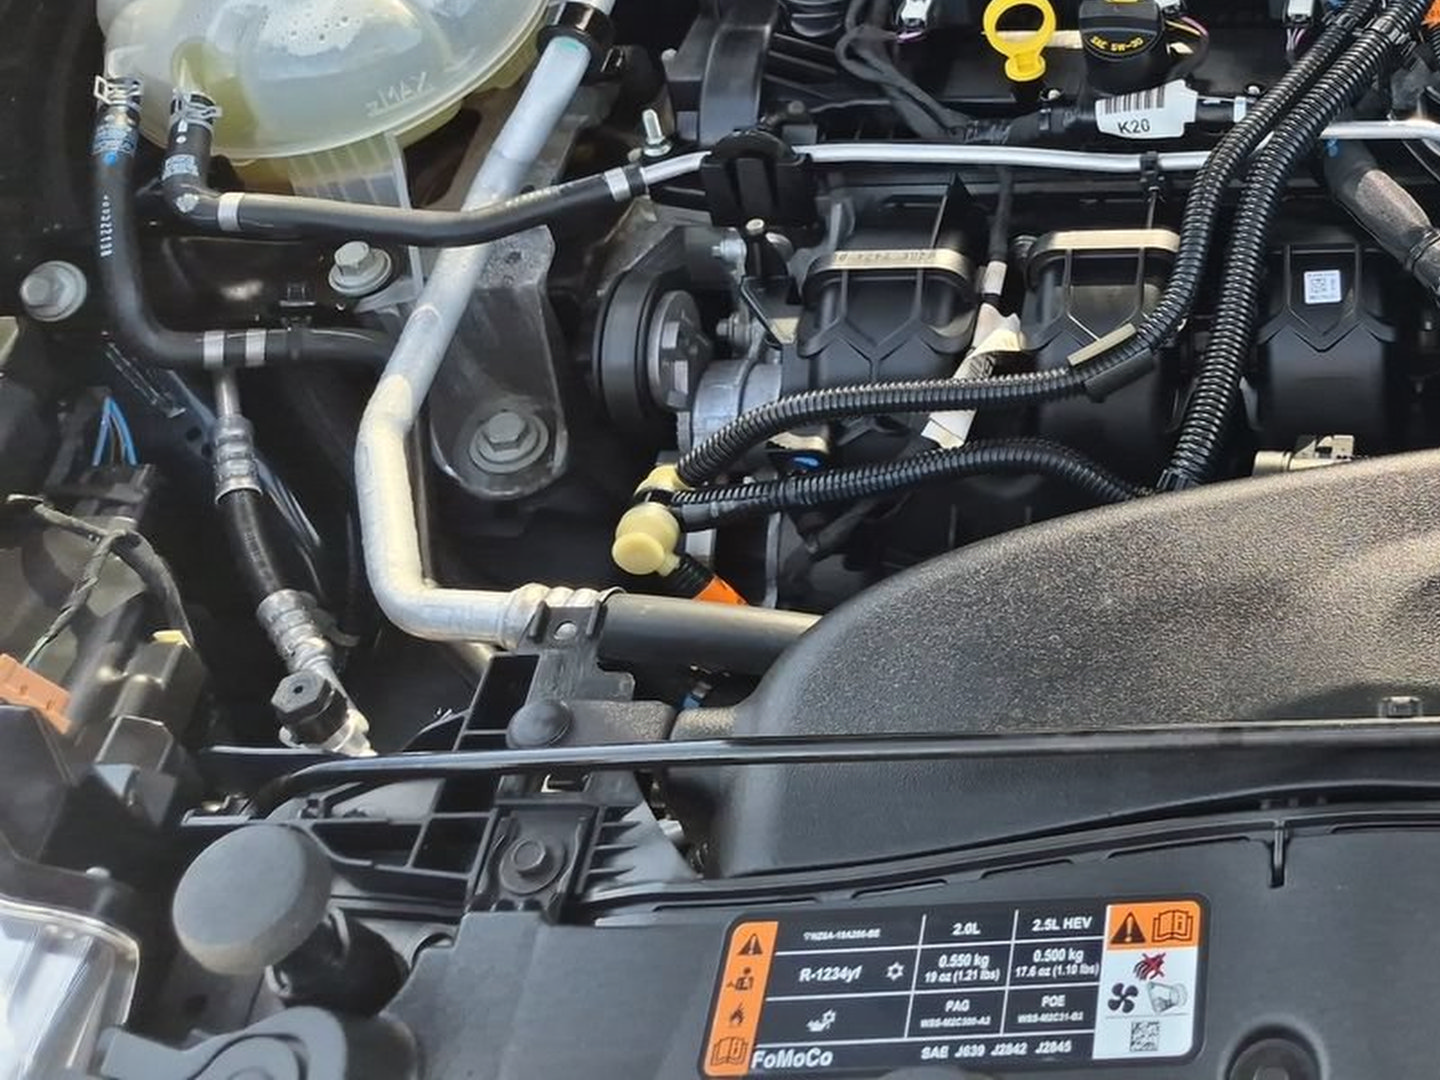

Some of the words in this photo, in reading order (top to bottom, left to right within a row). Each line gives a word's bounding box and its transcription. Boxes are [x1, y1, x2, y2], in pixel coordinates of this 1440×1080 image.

[1117, 118, 1151, 134] K20
[951, 922, 981, 936] 2.0L
[1031, 918, 1060, 932] 2.5L
[1062, 916, 1093, 930] HEV
[938, 954, 972, 969] 0.550
[973, 953, 990, 969] kg
[1032, 949, 1067, 963] 0.500
[1068, 948, 1085, 964] kg
[798, 965, 863, 984] R-1234yf
[750, 1047, 834, 1069] FoMoCo
[921, 1045, 949, 1060] SAE
